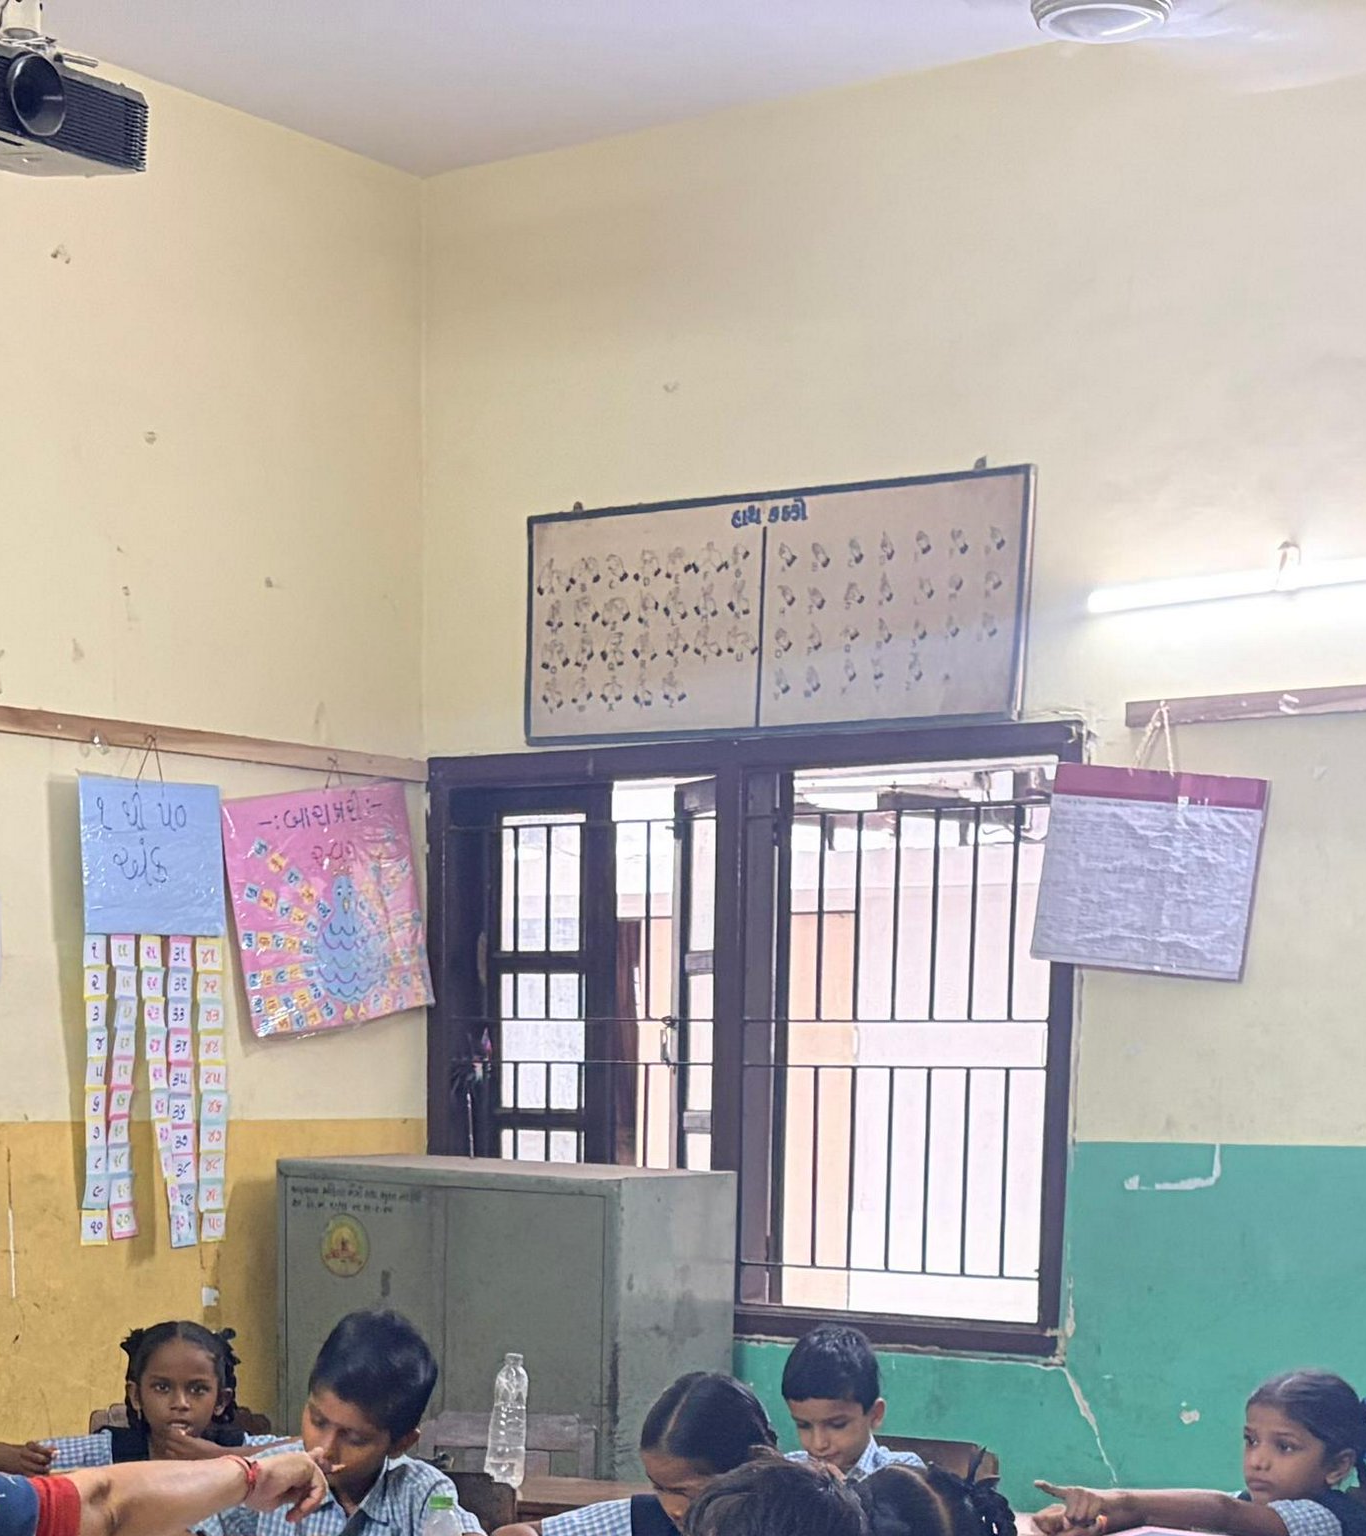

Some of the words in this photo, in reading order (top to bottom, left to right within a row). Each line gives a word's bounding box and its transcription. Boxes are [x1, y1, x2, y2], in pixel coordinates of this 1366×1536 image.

[157, 802, 187, 832] ૫૦
[173, 946, 187, 962] ૩૧
[91, 1005, 100, 1022] ૩
[171, 1007, 185, 1022] ૩૩
[174, 1040, 188, 1054] ૩૪
[172, 1072, 188, 1087] ૩૫
[171, 1104, 186, 1121] ૩૬
